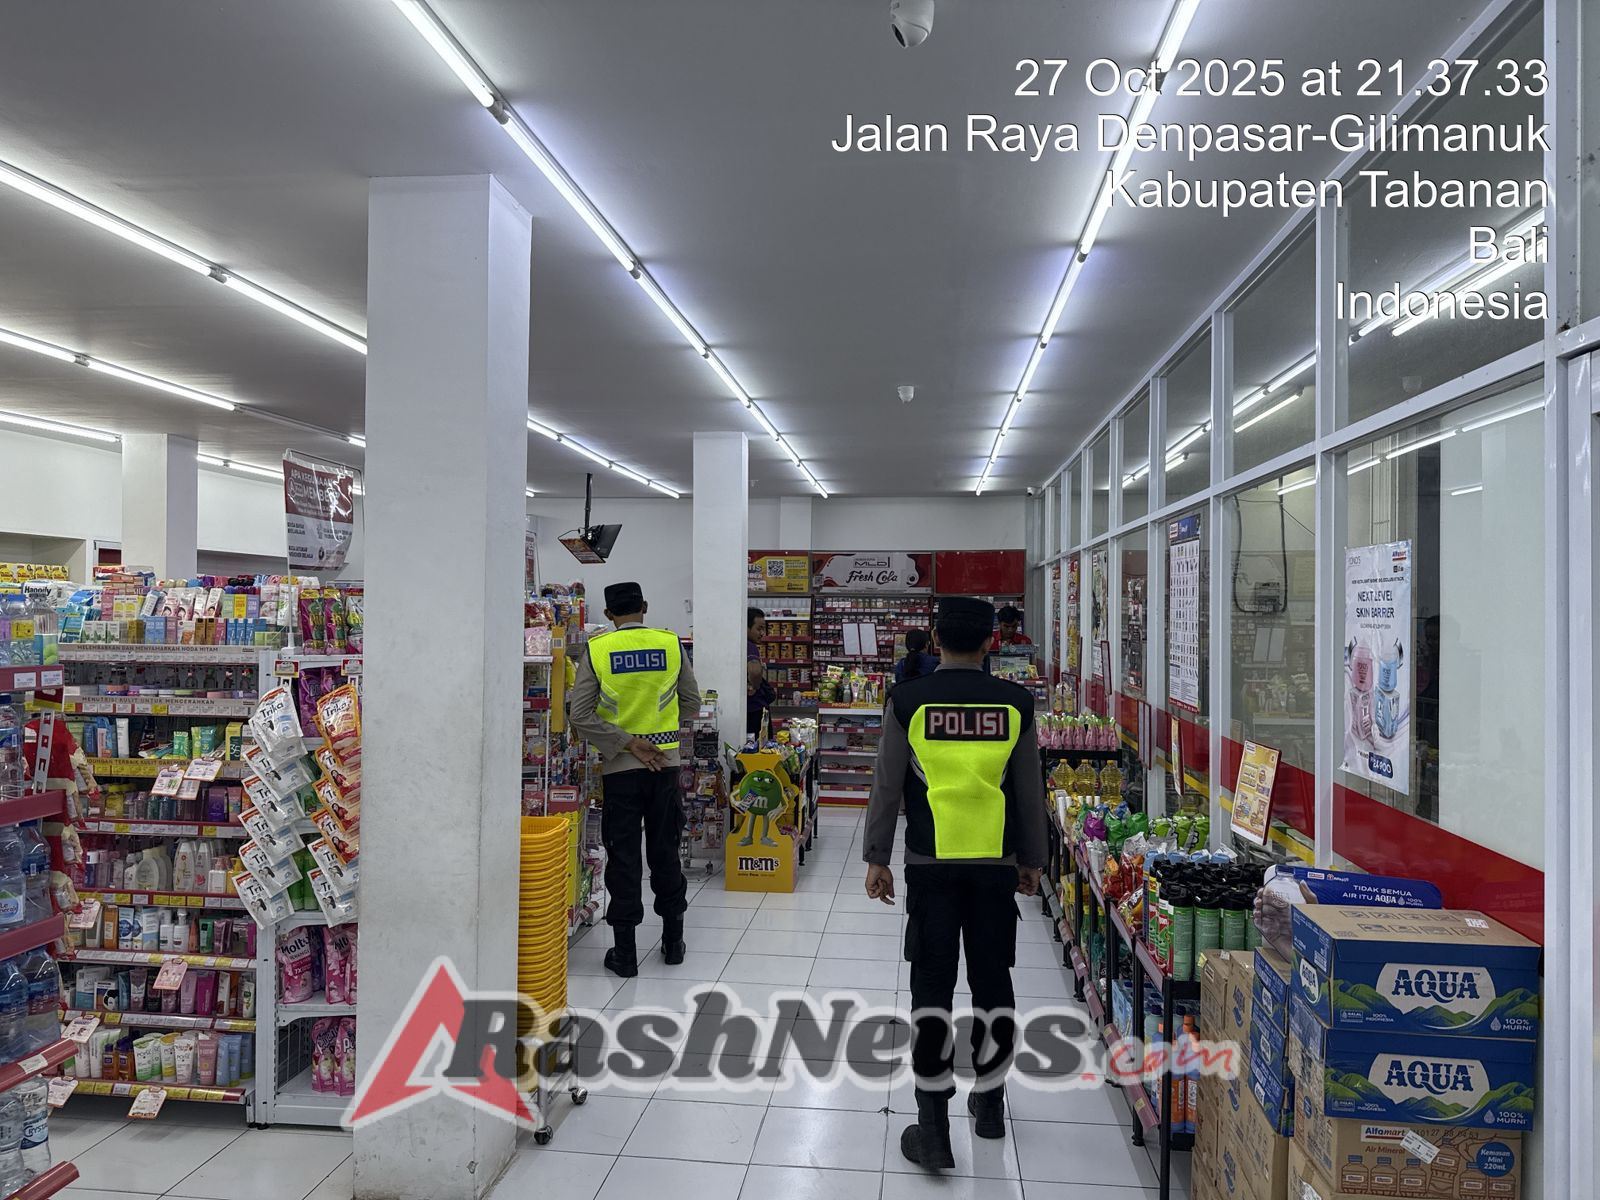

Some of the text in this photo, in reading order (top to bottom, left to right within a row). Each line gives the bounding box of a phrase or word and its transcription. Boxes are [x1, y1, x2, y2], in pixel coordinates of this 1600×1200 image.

[846, 570, 899, 585] Fresh Cola
[1357, 590, 1393, 602] NEXT LEVEL
[1355, 607, 1395, 619] SKIN BARRIER
[612, 653, 666, 670] POLISI
[259, 701, 284, 719] Trika
[325, 701, 349, 718] Trika
[929, 711, 1005, 736] POLISI
[256, 788, 272, 800] Tri
[1353, 884, 1413, 897] TIDAK SEMUA
[1342, 891, 1398, 905] AIR ITU AQUA
[1391, 968, 1480, 1004] AQUA
[1502, 1023, 1532, 1032] MURNI
[1504, 1018, 1531, 1026] 100%
[1384, 1059, 1474, 1096] AQUA
[1498, 1111, 1525, 1119] 100%
[1496, 1117, 1527, 1126] MURNI
[1365, 1126, 1405, 1138] Alfamart
[1365, 1145, 1377, 1154] Air
[1480, 1148, 1511, 1157] Kemasan
[1487, 1156, 1504, 1164] Mini
